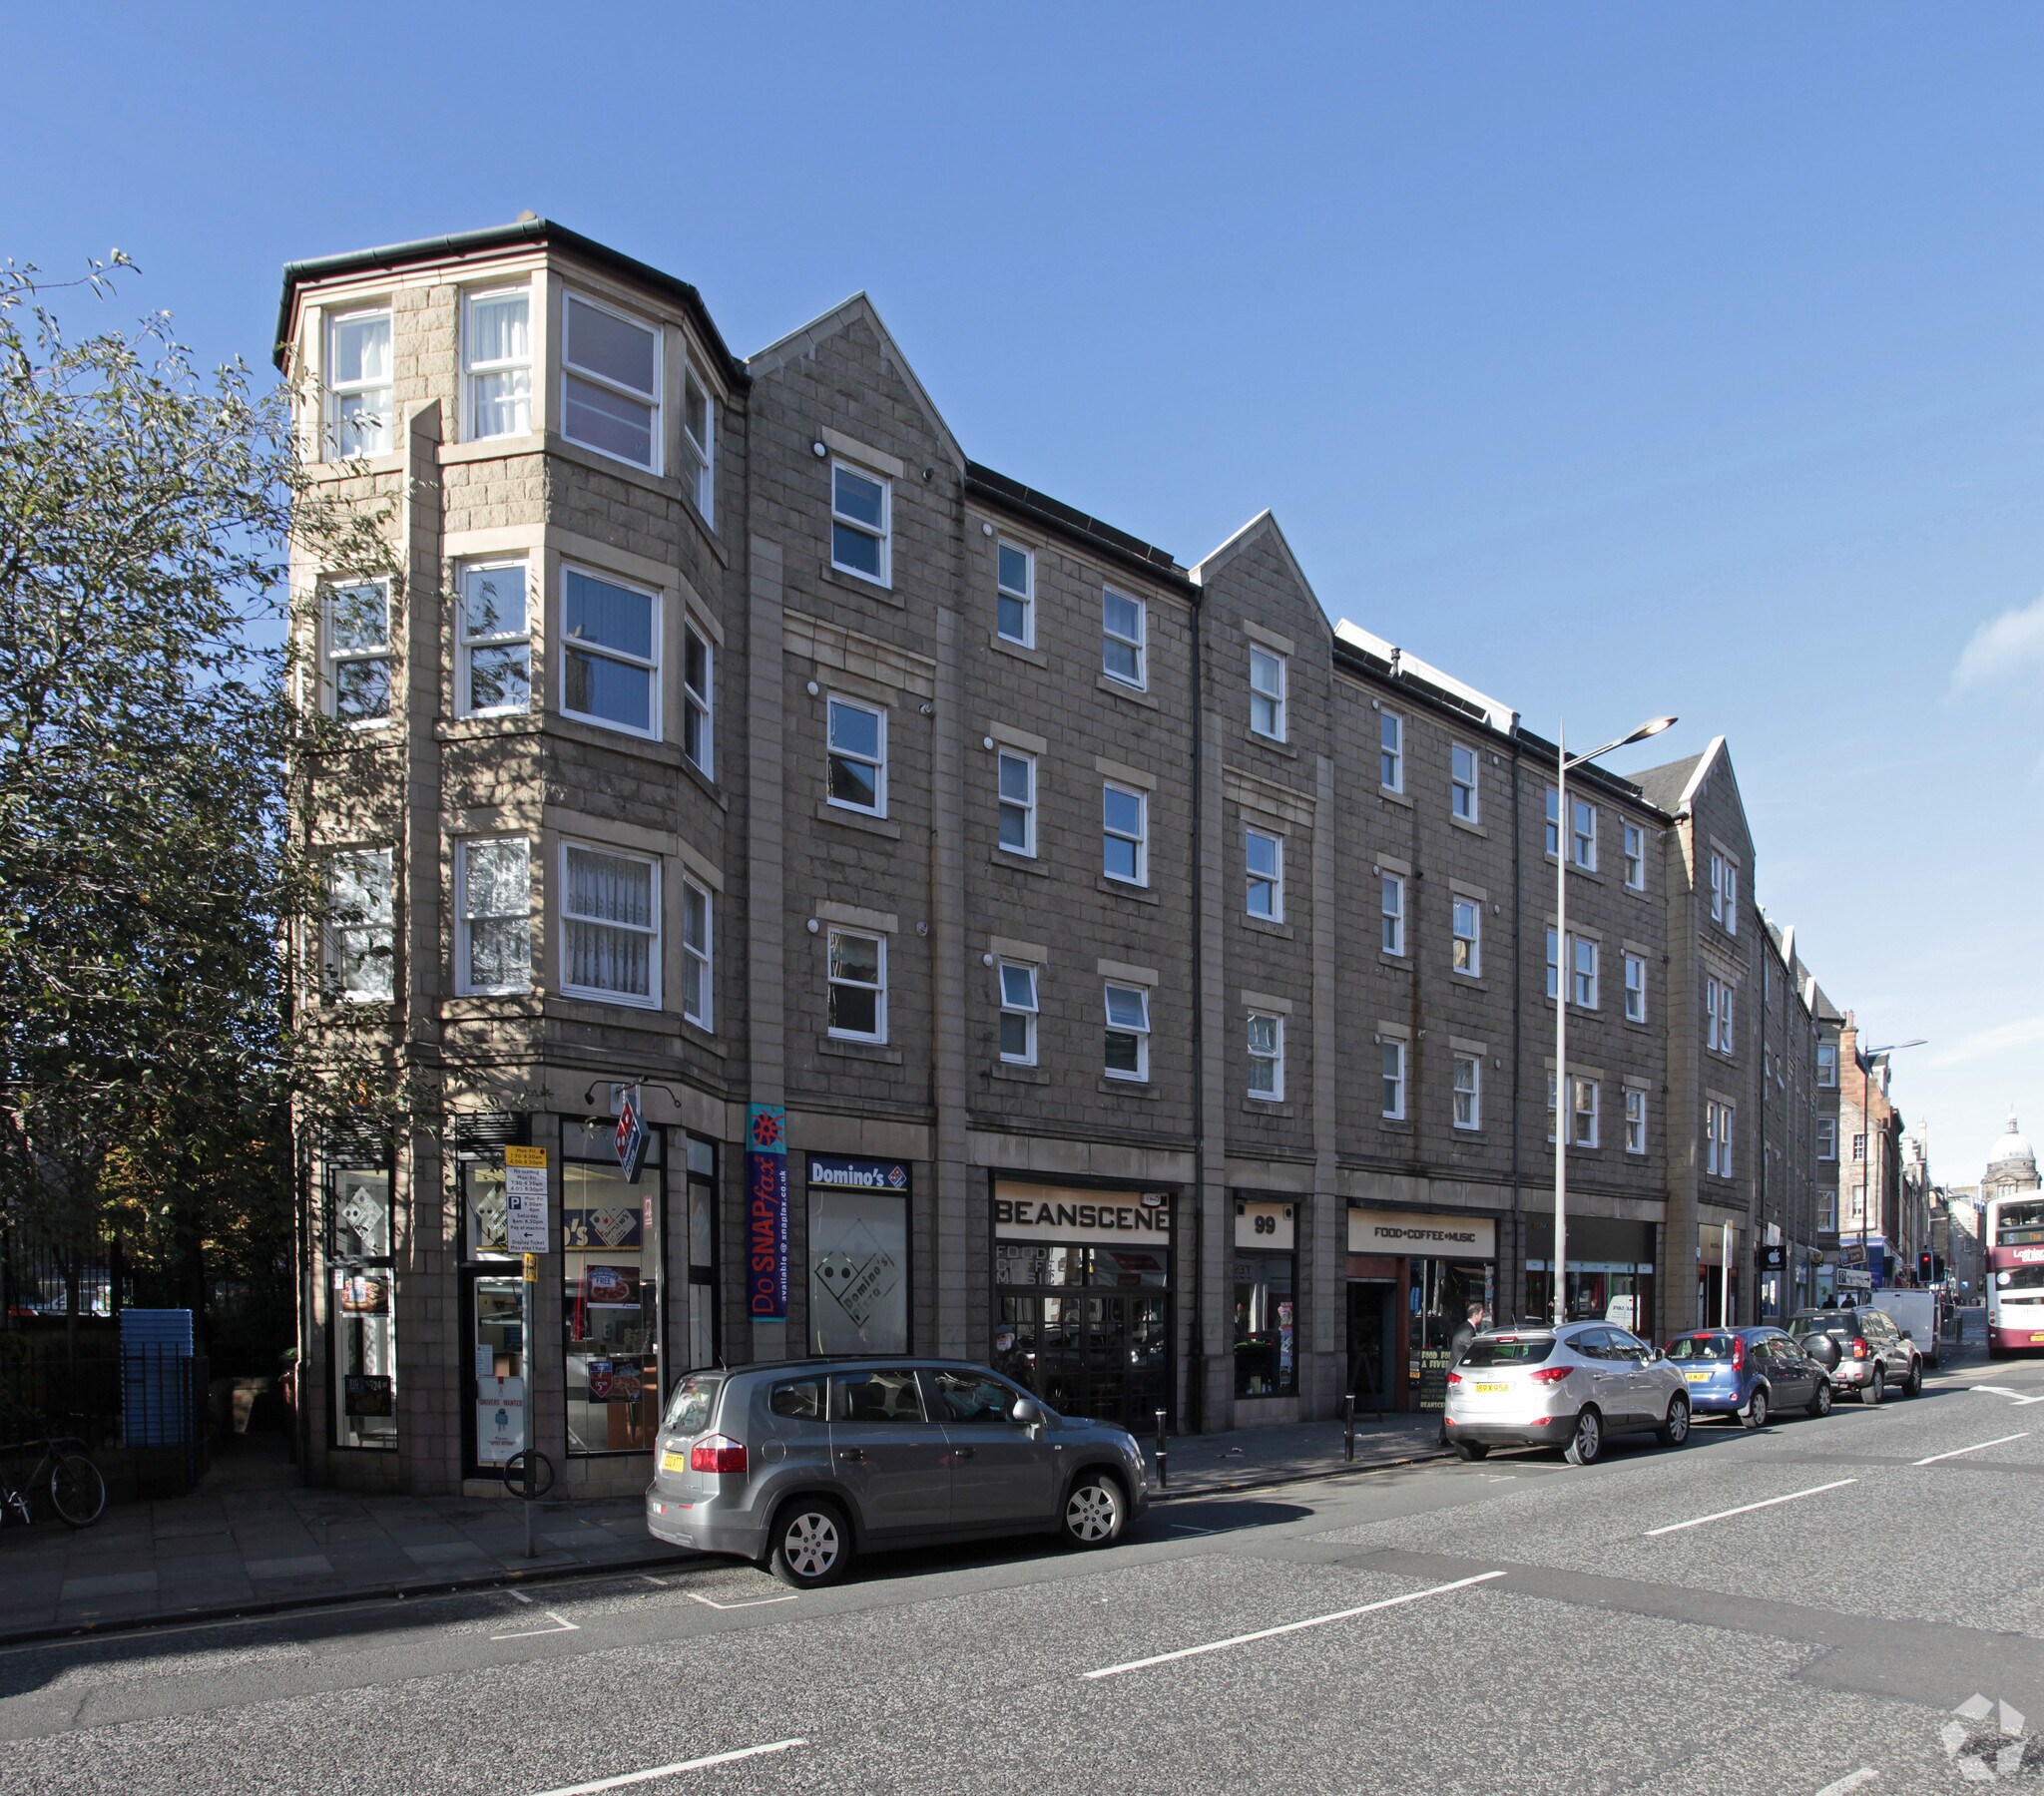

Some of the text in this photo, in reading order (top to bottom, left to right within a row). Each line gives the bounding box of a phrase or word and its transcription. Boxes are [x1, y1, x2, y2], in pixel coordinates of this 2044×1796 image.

[812, 1162, 884, 1187] Domino's
[511, 1197, 519, 1209] P
[778, 1170, 787, 1240] snapfax.co.uk
[995, 1200, 1170, 1230] BEANSCENE
[1255, 1215, 1276, 1234] 99
[779, 1242, 787, 1253] @
[996, 1245, 1047, 1259] FOOD
[843, 1257, 888, 1310] Domino's
[752, 1278, 774, 1313] Do
[1421, 1350, 1437, 1359] FOOD
